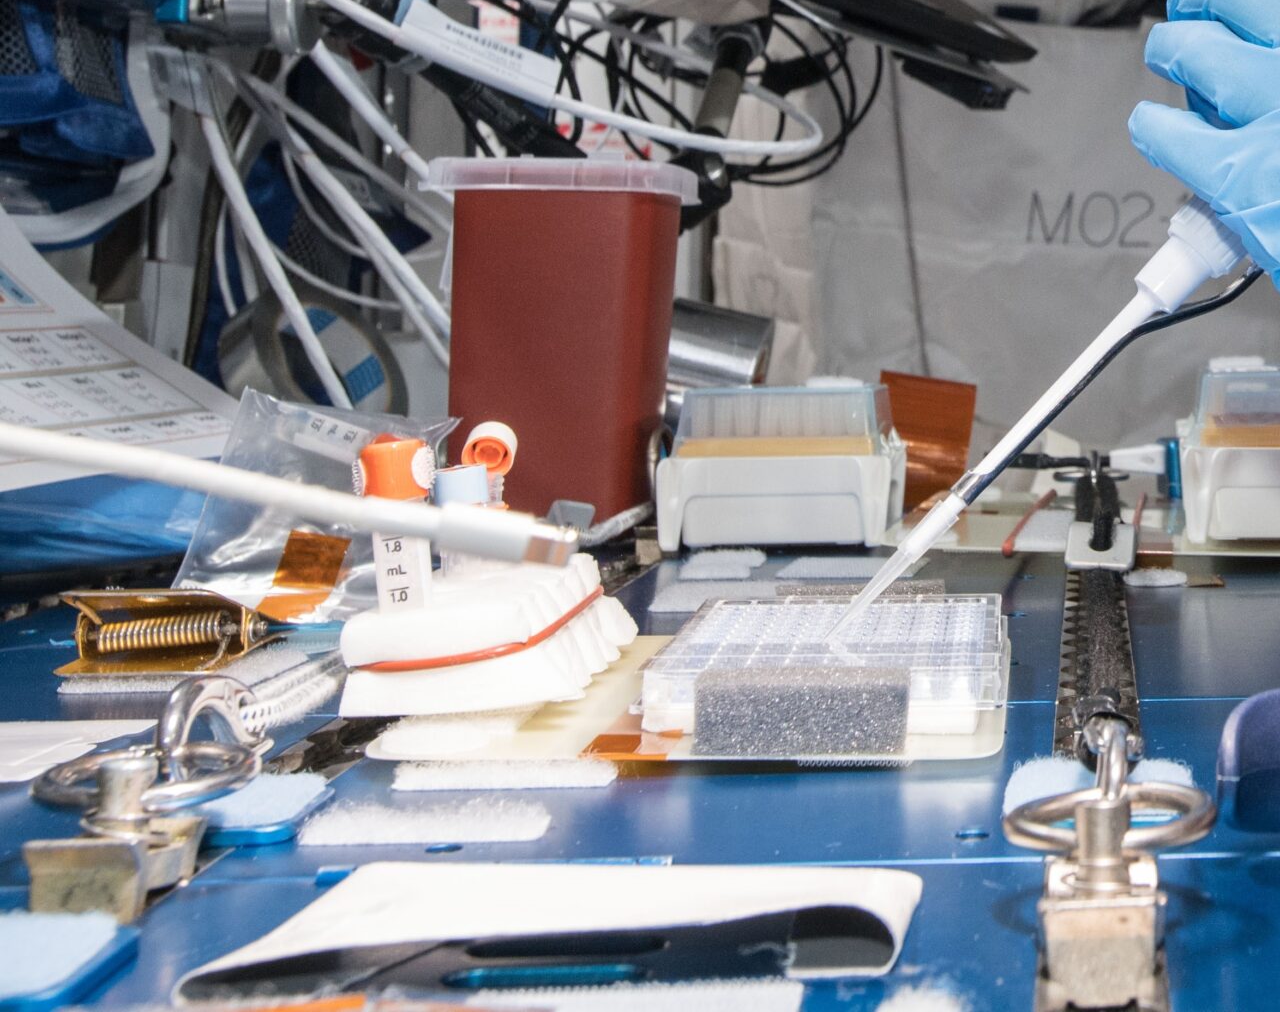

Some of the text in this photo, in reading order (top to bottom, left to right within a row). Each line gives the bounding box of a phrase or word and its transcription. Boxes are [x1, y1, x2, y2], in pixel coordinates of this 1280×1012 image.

[384, 541, 403, 553] 1.8
[386, 565, 408, 577] mL
[389, 591, 409, 604] 1.0
